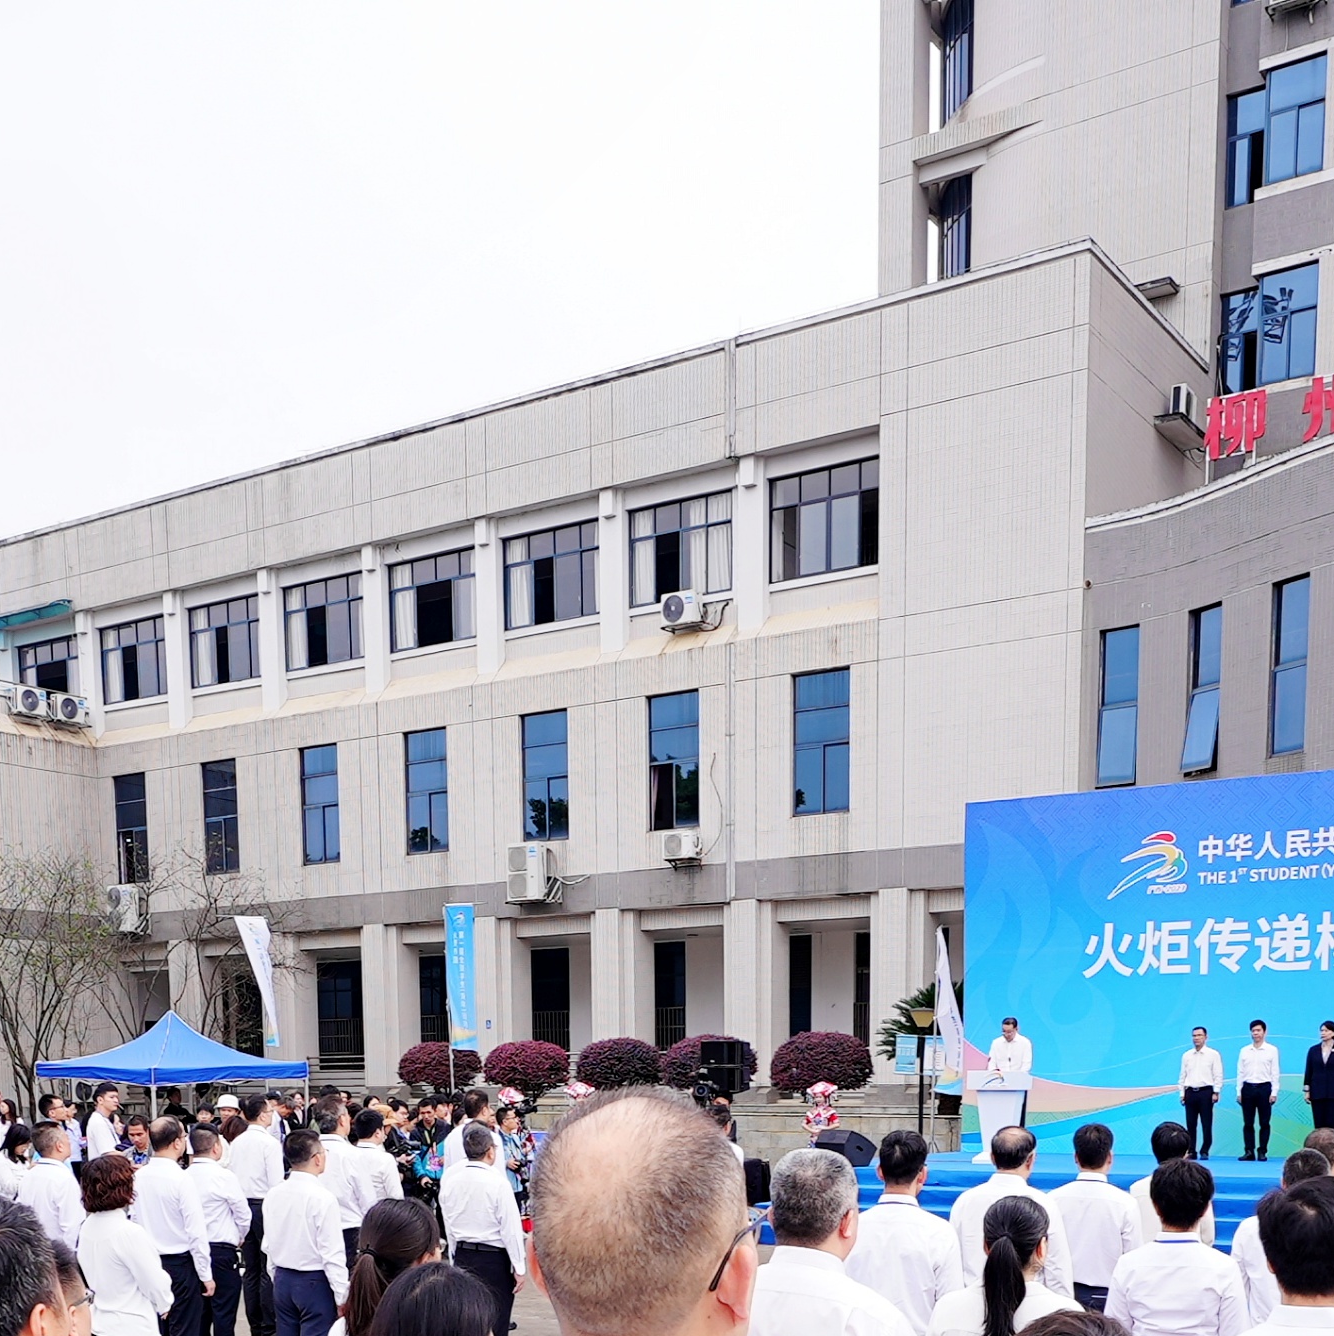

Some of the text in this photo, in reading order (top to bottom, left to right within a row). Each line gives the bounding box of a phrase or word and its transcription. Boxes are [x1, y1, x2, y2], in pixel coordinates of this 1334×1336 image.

[1198, 872, 1227, 885] THE
[1229, 867, 1248, 884] 1ST
[1249, 865, 1319, 883] STUDENT
